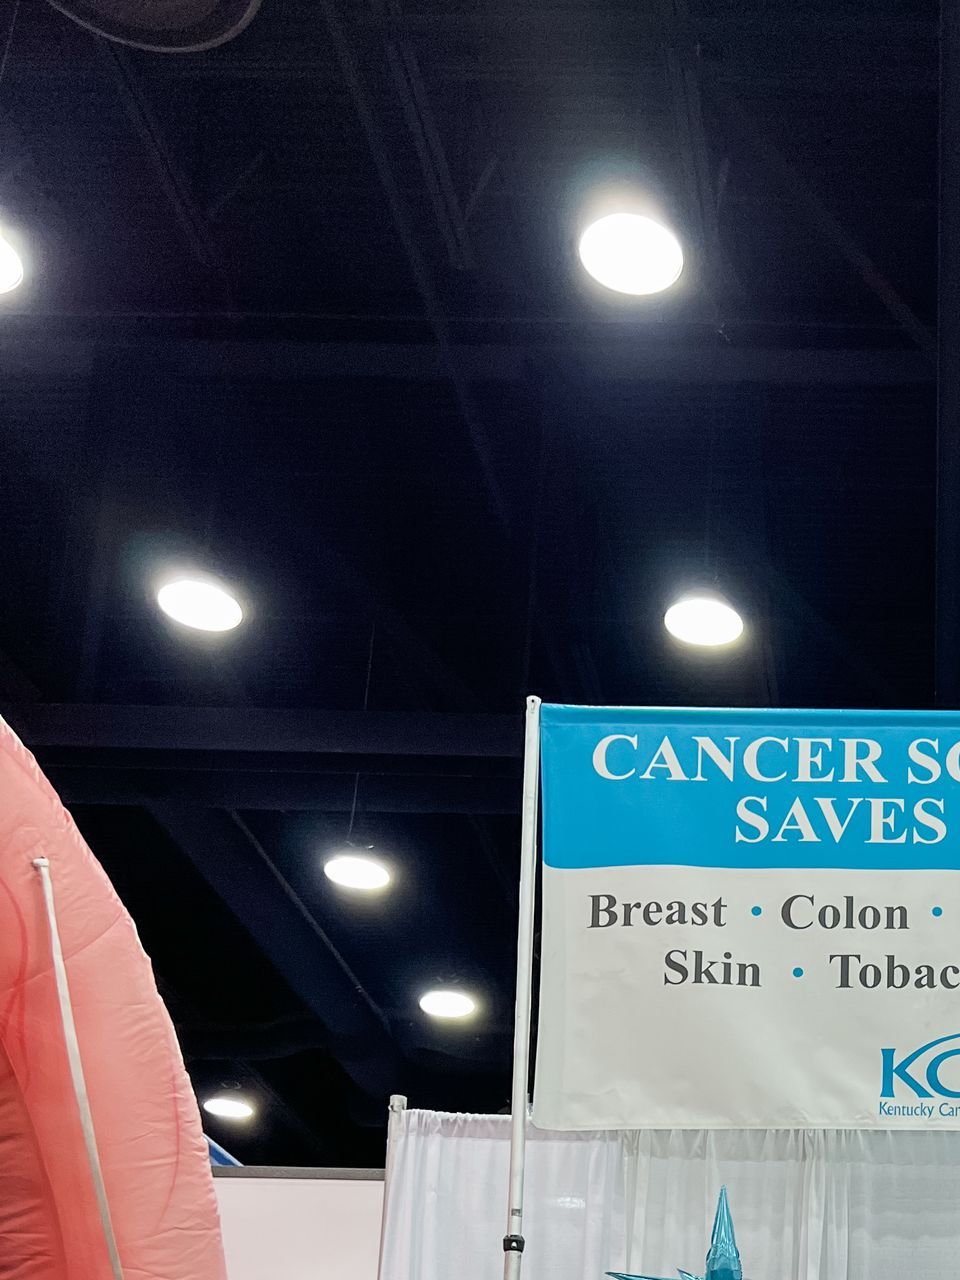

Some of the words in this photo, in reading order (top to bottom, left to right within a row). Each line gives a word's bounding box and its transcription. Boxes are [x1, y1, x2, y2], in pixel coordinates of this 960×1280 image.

[592, 734, 888, 783] CANCER
[735, 796, 947, 846] SAVES
[586, 893, 728, 930] Breast
[780, 894, 910, 932] Colon
[663, 949, 762, 988] Skin
[879, 1101, 935, 1118] Kentucky
